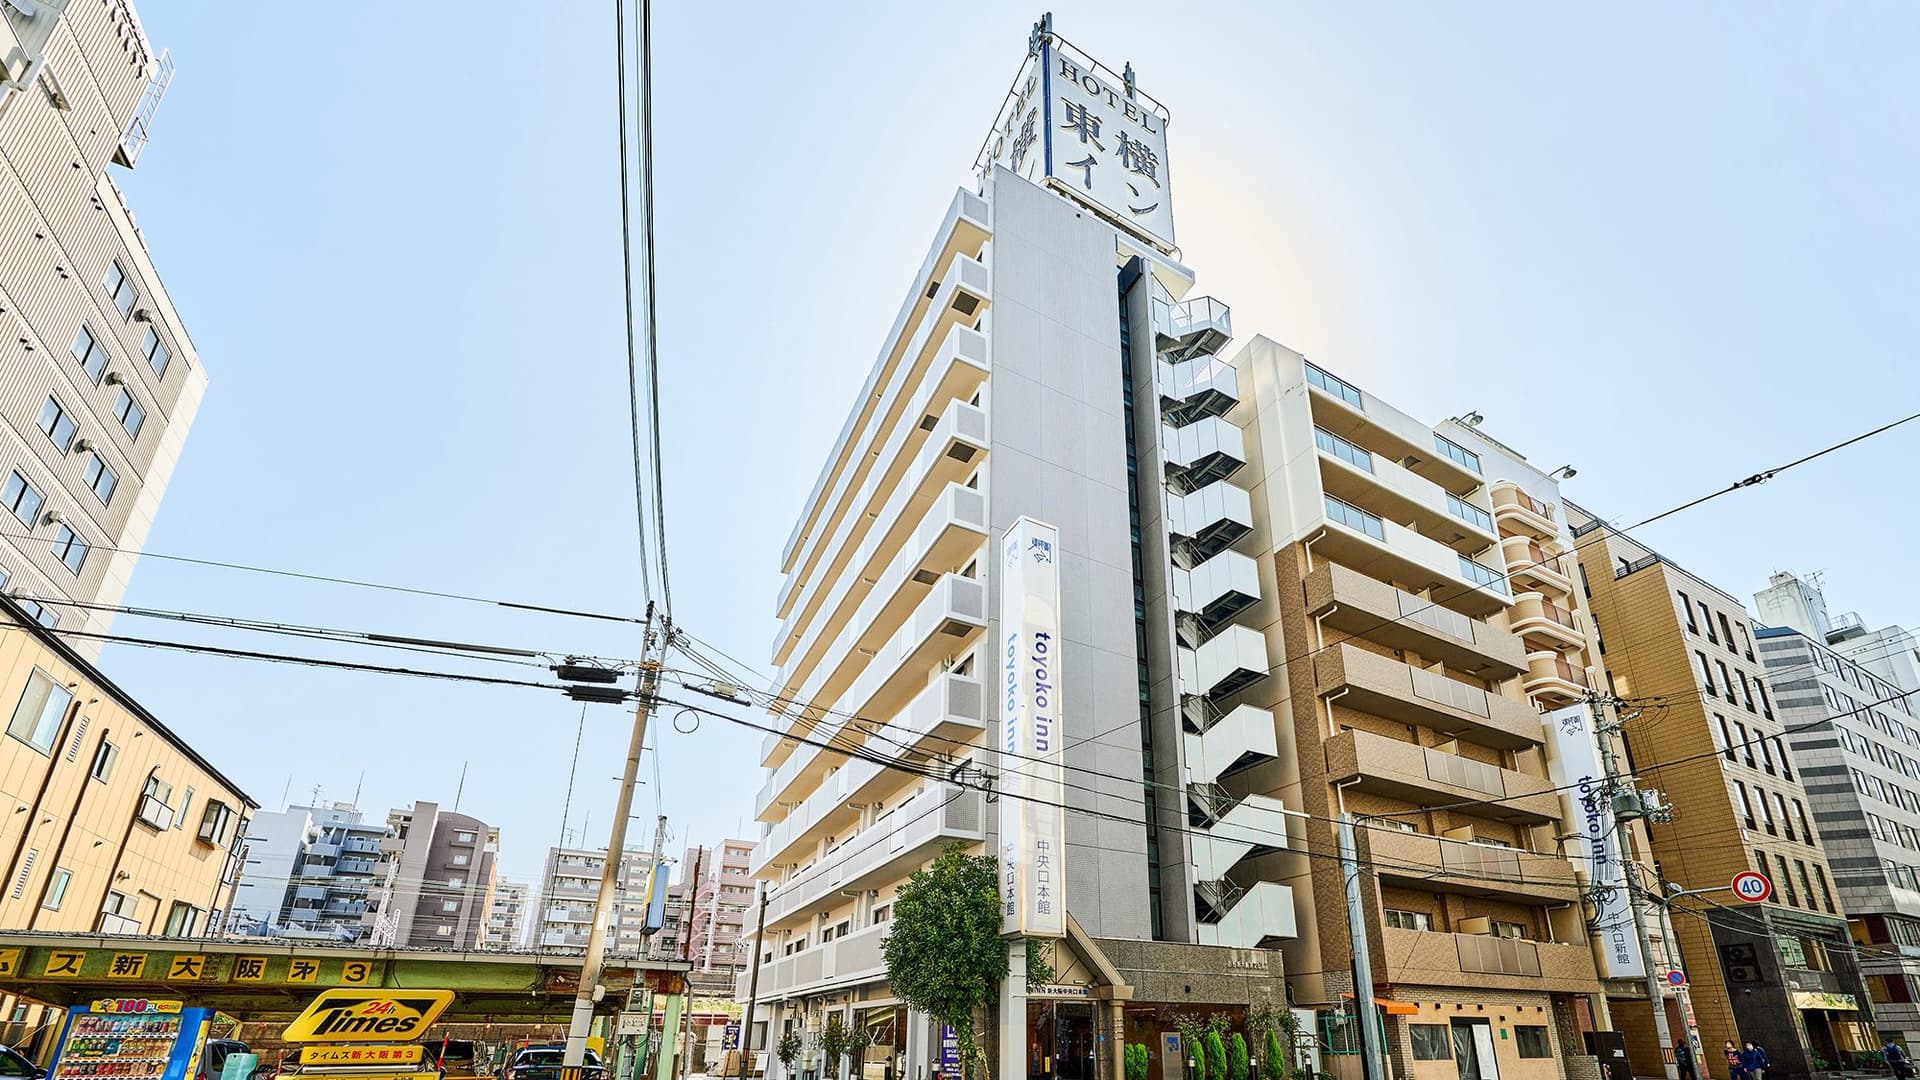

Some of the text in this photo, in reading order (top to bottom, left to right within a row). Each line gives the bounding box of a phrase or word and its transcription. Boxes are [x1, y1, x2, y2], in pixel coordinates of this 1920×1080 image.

[1059, 58, 1157, 135] HOTEL
[1060, 96, 1161, 189] 東横
[1065, 153, 1159, 216] イン
[1005, 632, 1018, 754] toyoko inn
[1031, 631, 1053, 752] toyoko inn
[1578, 775, 1607, 865] toyoko inn
[1036, 839, 1050, 915] 中央口本館
[1741, 879, 1762, 895] 40
[1607, 911, 1630, 964] 中央口新館
[311, 1008, 421, 1036] Times
[362, 1001, 396, 1015] 24h
